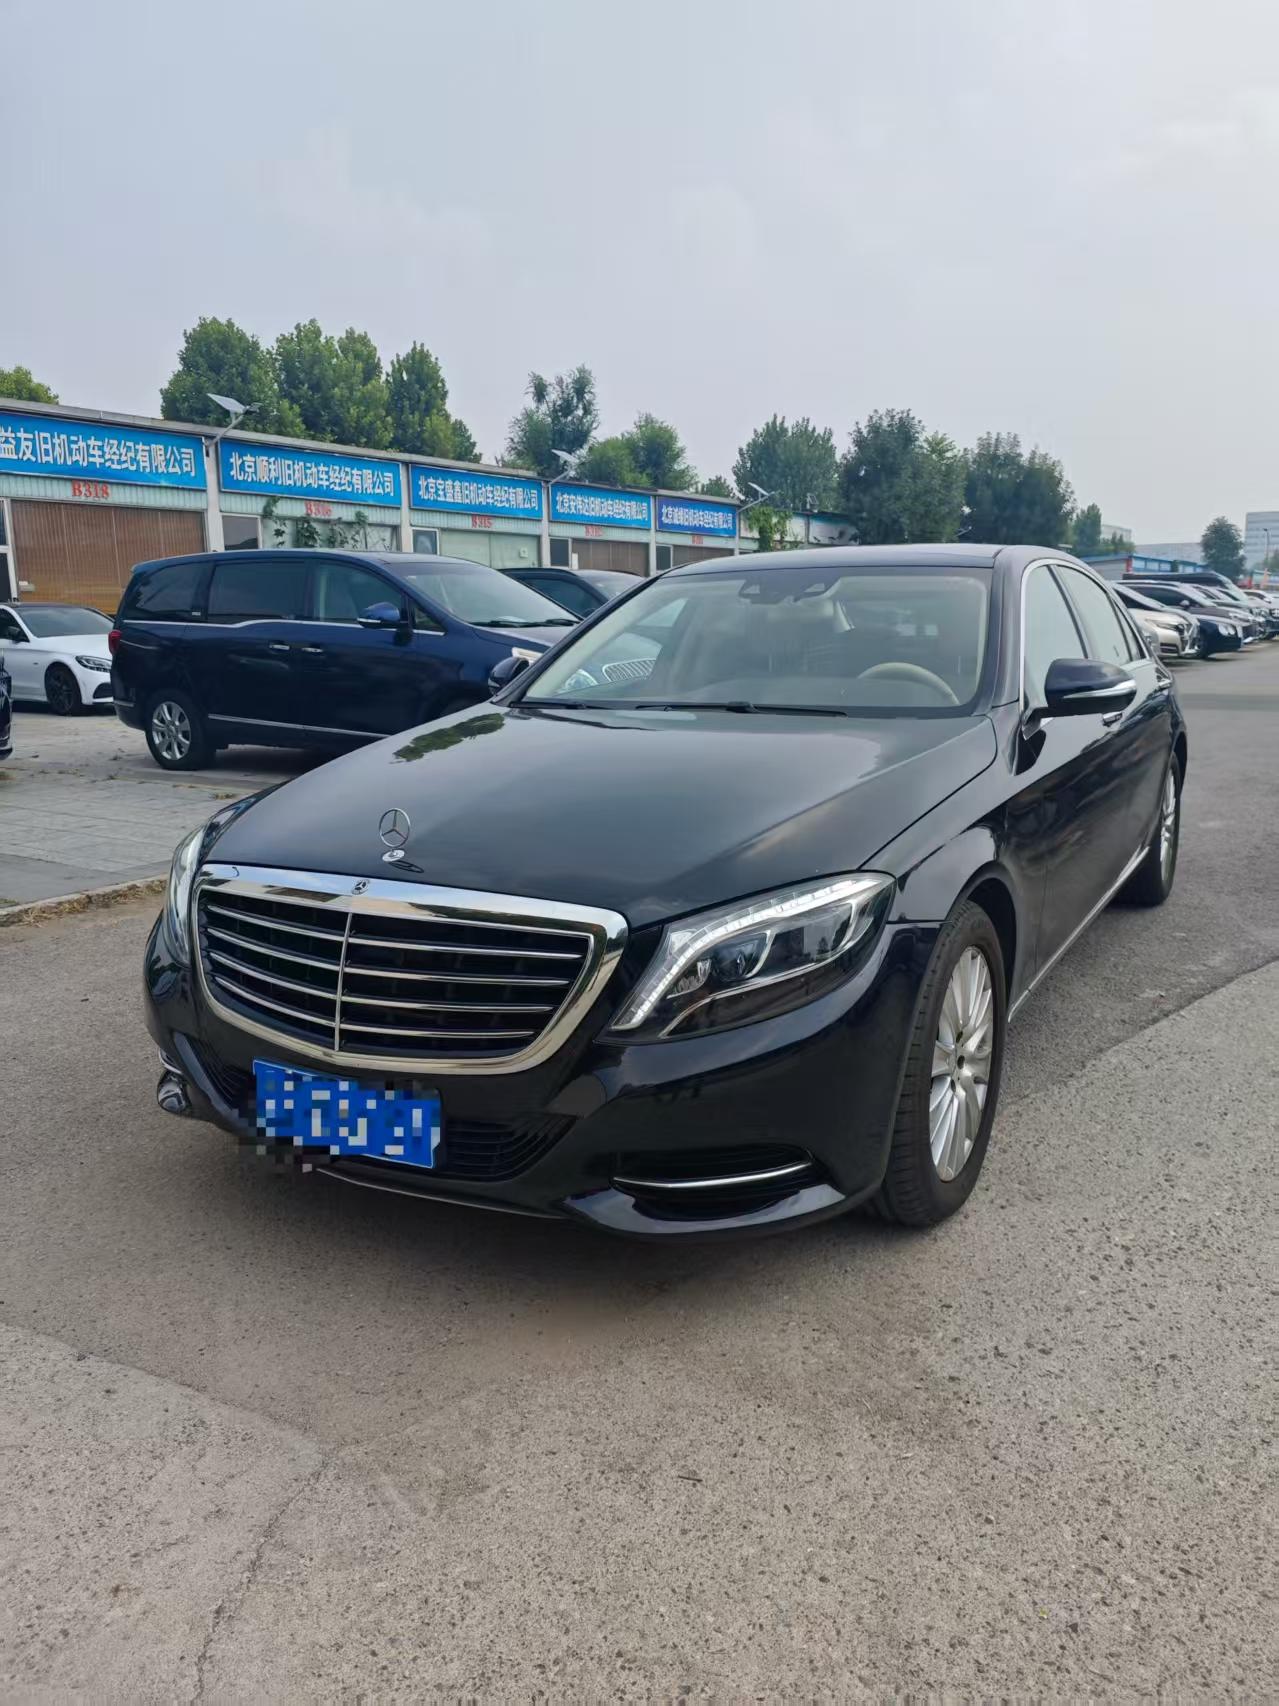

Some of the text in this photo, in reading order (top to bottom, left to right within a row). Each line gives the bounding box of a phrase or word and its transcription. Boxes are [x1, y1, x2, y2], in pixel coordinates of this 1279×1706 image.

[0, 425, 196, 477] 益友旧机动车经纪有限公司
[71, 480, 110, 499] B318
[230, 452, 394, 496] 北京顺利旧机动车经纪有限公司
